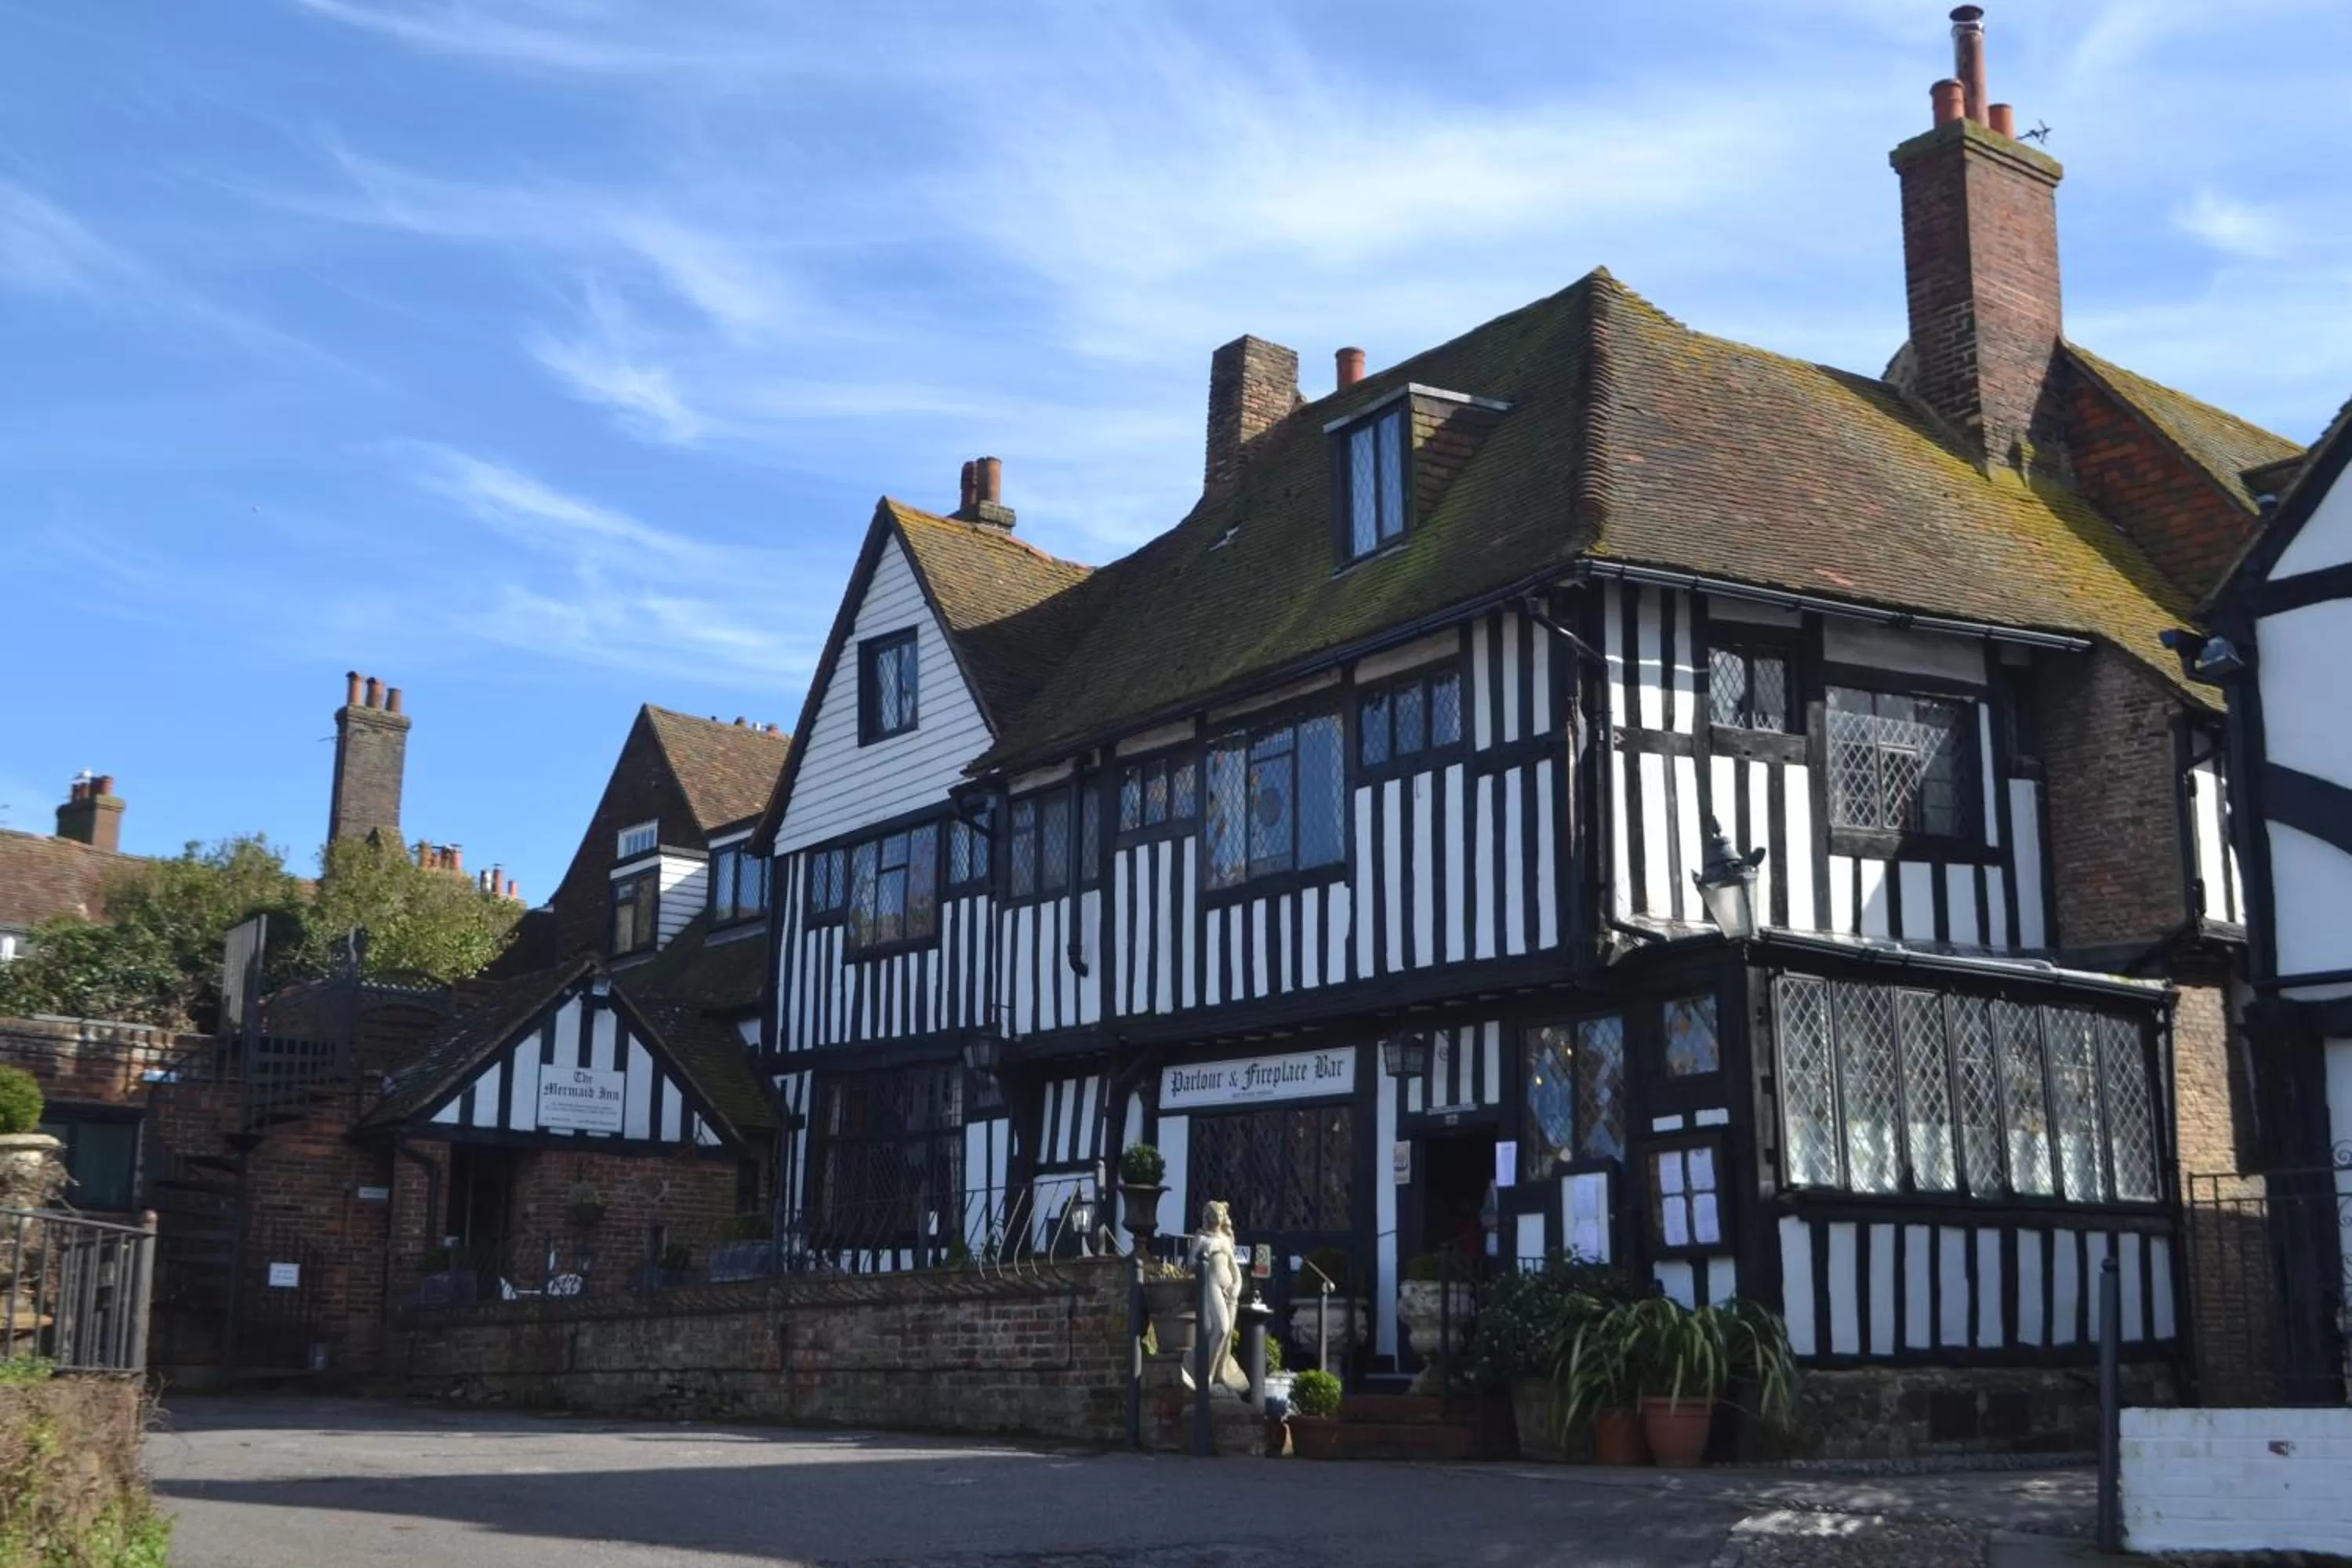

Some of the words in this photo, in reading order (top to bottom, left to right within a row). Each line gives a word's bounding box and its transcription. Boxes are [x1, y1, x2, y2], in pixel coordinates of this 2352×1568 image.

[573, 1071, 593, 1083] The
[1171, 1069, 1223, 1097] Parlour
[1229, 1070, 1239, 1087] &
[1242, 1062, 1308, 1091] Fireplace
[1314, 1054, 1345, 1079] Bar
[543, 1082, 593, 1098] Mermaid
[597, 1086, 619, 1101] Inn
